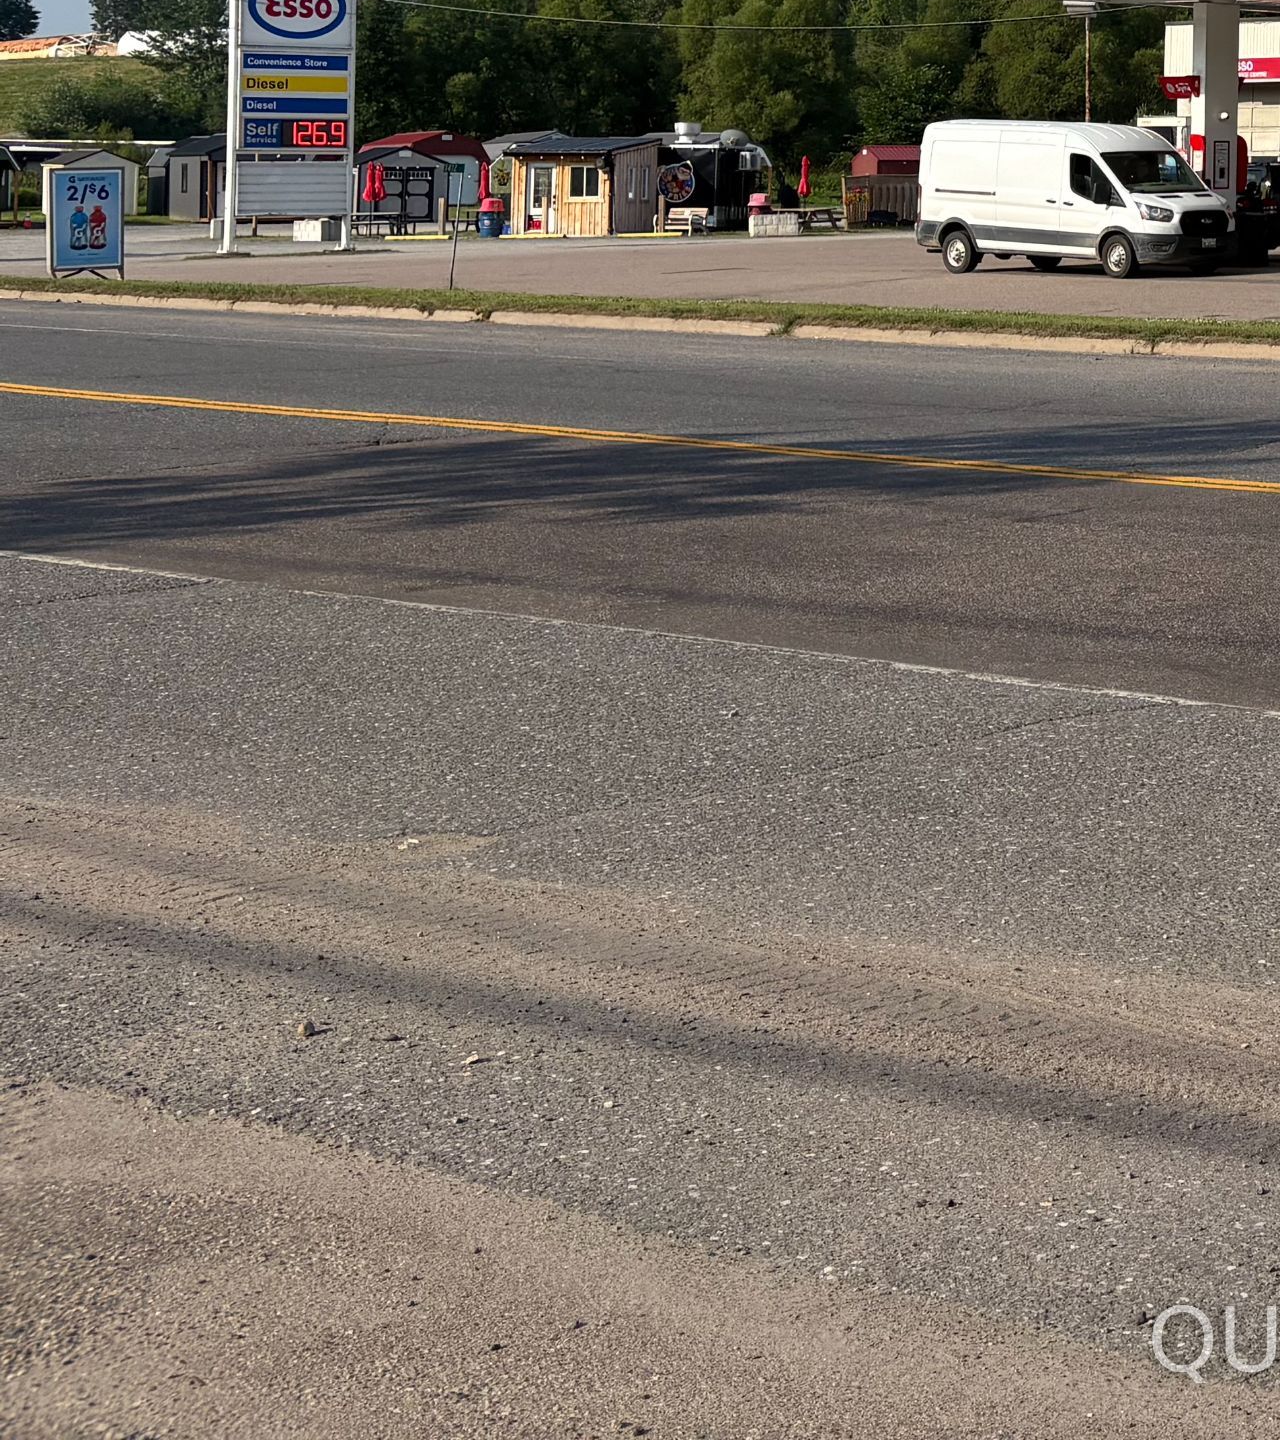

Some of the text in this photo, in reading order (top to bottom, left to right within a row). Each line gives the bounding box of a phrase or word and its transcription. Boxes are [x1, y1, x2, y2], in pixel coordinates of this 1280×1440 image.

[247, 56, 328, 67] Convenience Store
[246, 77, 289, 90] Diesel
[246, 100, 277, 110] Diesel
[246, 122, 279, 136] Self
[292, 121, 345, 146] 126.9
[246, 136, 277, 144] Service
